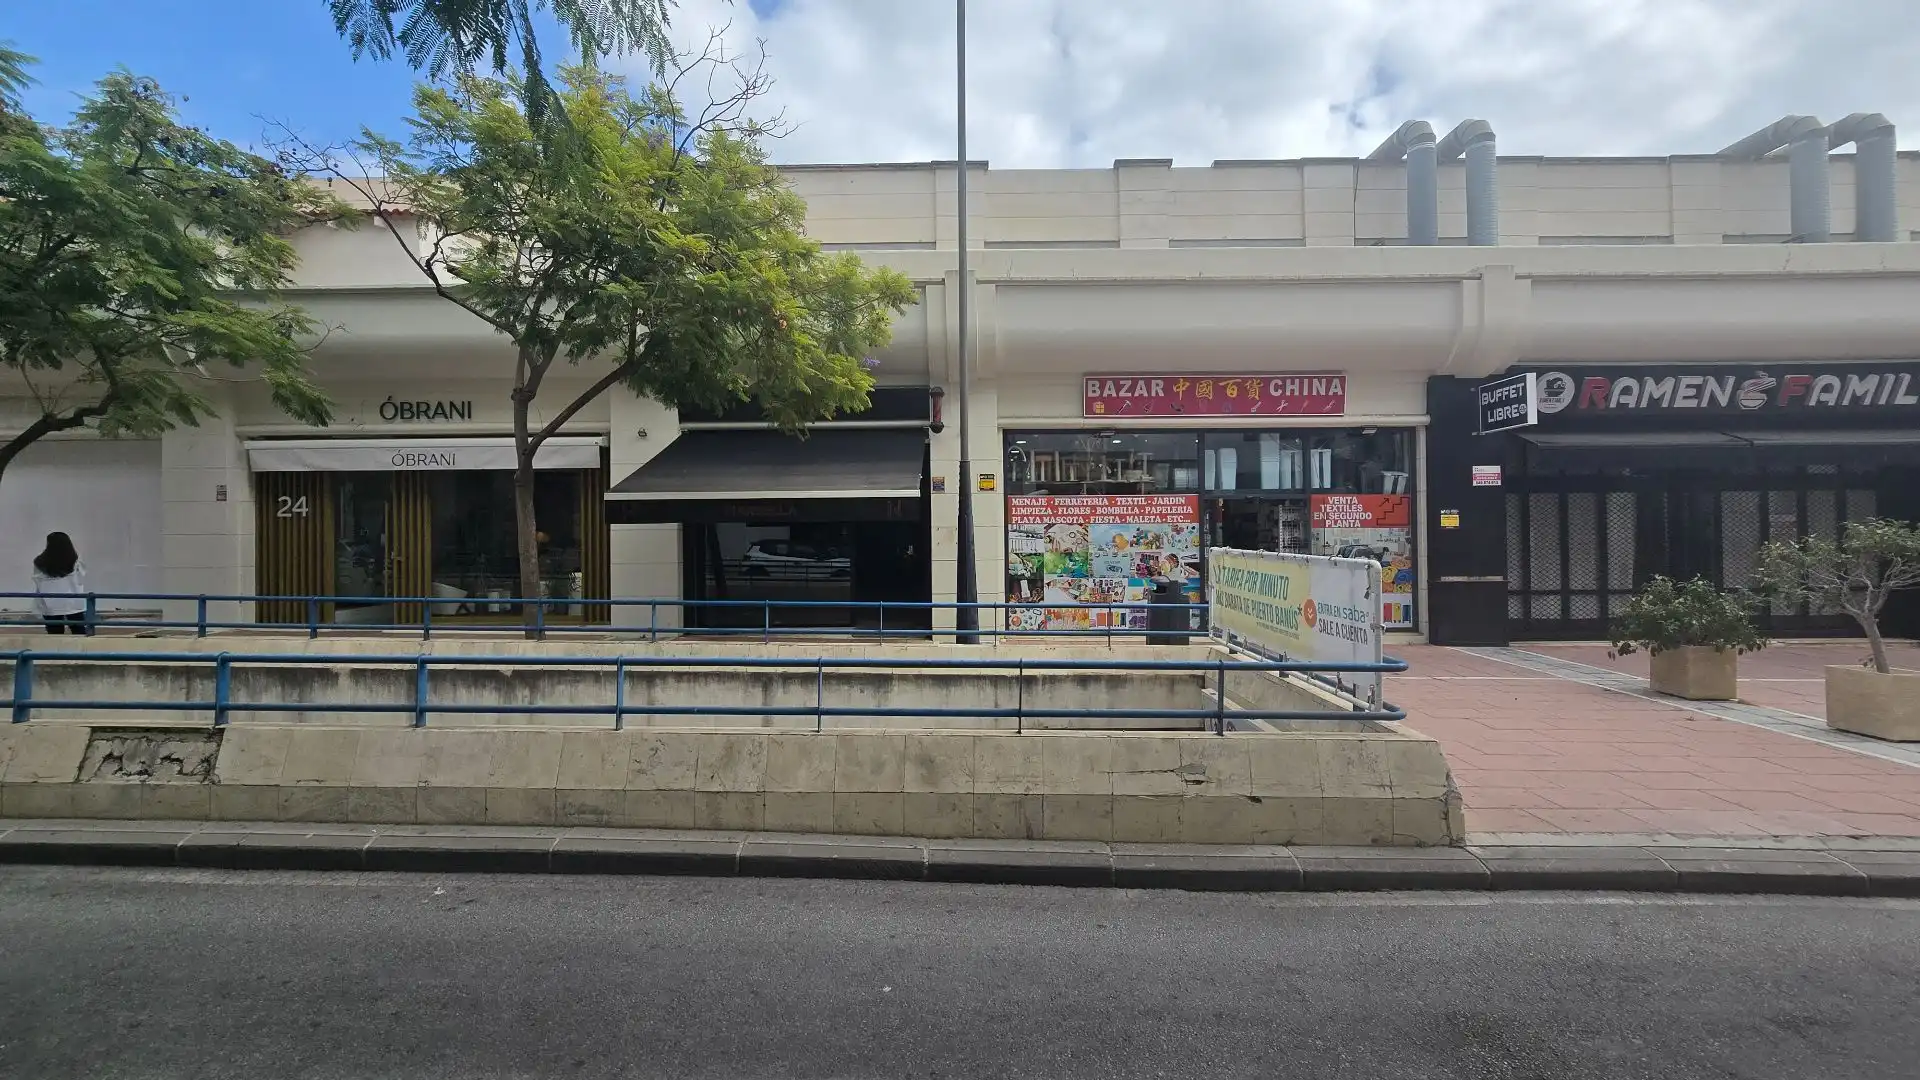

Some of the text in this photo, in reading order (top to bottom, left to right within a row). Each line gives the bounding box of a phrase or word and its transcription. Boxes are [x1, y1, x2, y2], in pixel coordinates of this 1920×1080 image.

[1087, 377, 1343, 401] BAZAR 中國百貨 CHINA
[1481, 382, 1525, 406] BUFFET
[1579, 376, 1736, 409] RAMEN
[379, 395, 472, 420] ÓBRANI
[1487, 403, 1520, 423] LIBRE
[391, 449, 456, 467] ÓBRANI
[277, 495, 309, 518] 24
[1011, 498, 1048, 506] MENAJE
[1116, 497, 1147, 506] TEXTIL
[1152, 496, 1186, 505] JARDIN
[1320, 504, 1363, 513] TEXTILES
[1328, 496, 1359, 504] VENTA
[1011, 507, 1053, 515] LIMPIEZA
[1058, 507, 1091, 515] FLORES
[1096, 506, 1140, 515] BOMBILLA
[1012, 516, 1041, 524] PLAYA
[1043, 516, 1085, 524] MASCOTA
[1090, 515, 1121, 524] FIESTA
[1126, 515, 1161, 523] MALETA
[1313, 511, 1372, 520] EN SEGUNDO
[1325, 519, 1361, 528] PLANTA
[1222, 566, 1246, 591] TARIFA
[1245, 570, 1259, 594] POR
[1258, 573, 1290, 601] MINUTO
[1243, 598, 1252, 616] DE
[1251, 600, 1275, 623] PUERTO
[1317, 602, 1334, 616] ENTRA
[1333, 605, 1341, 618] EN
[1318, 618, 1335, 637] SALE
[1335, 622, 1341, 639] A
[1341, 623, 1368, 645] CUENTA
